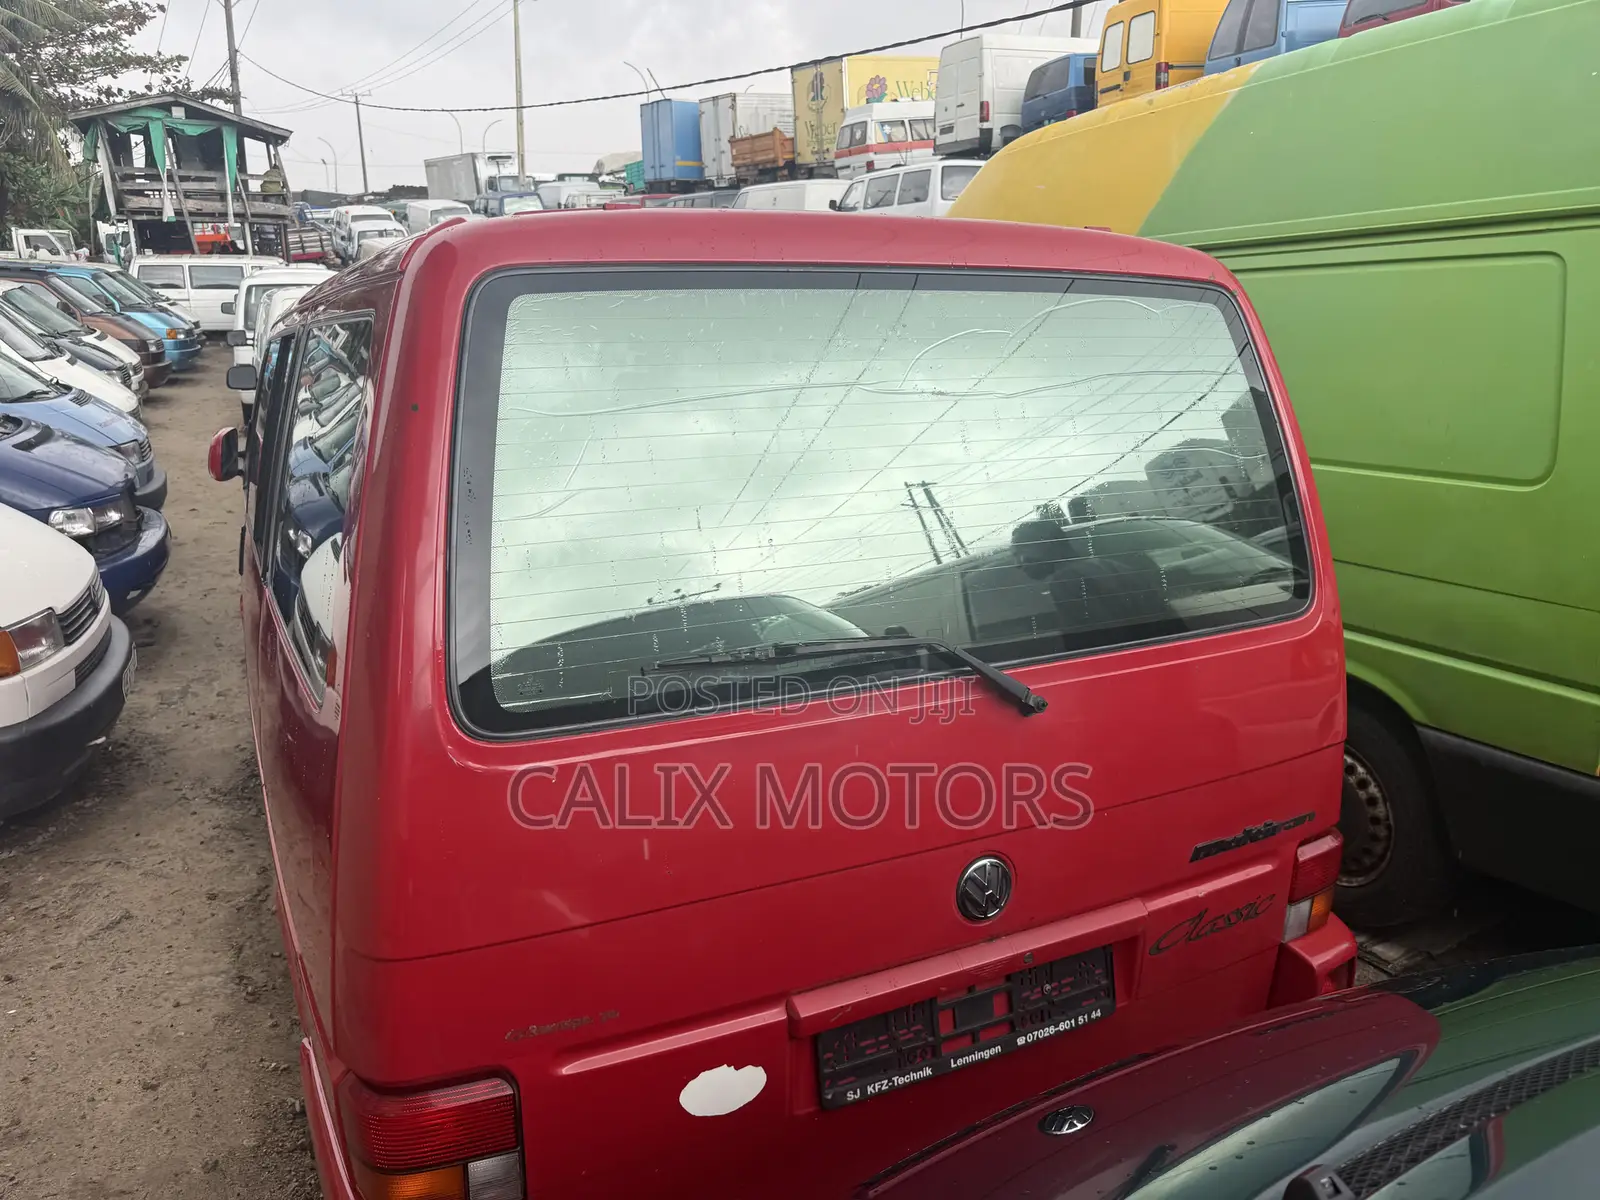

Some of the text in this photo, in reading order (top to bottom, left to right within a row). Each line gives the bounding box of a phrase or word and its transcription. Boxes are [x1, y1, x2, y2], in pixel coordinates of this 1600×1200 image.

[846, 1089, 860, 1101] SJ
[867, 1066, 932, 1096] KFZ-Technik
[950, 1045, 1002, 1068] Lenningen
[1078, 1013, 1088, 1027] 51
[1091, 1009, 1101, 1022] 44
